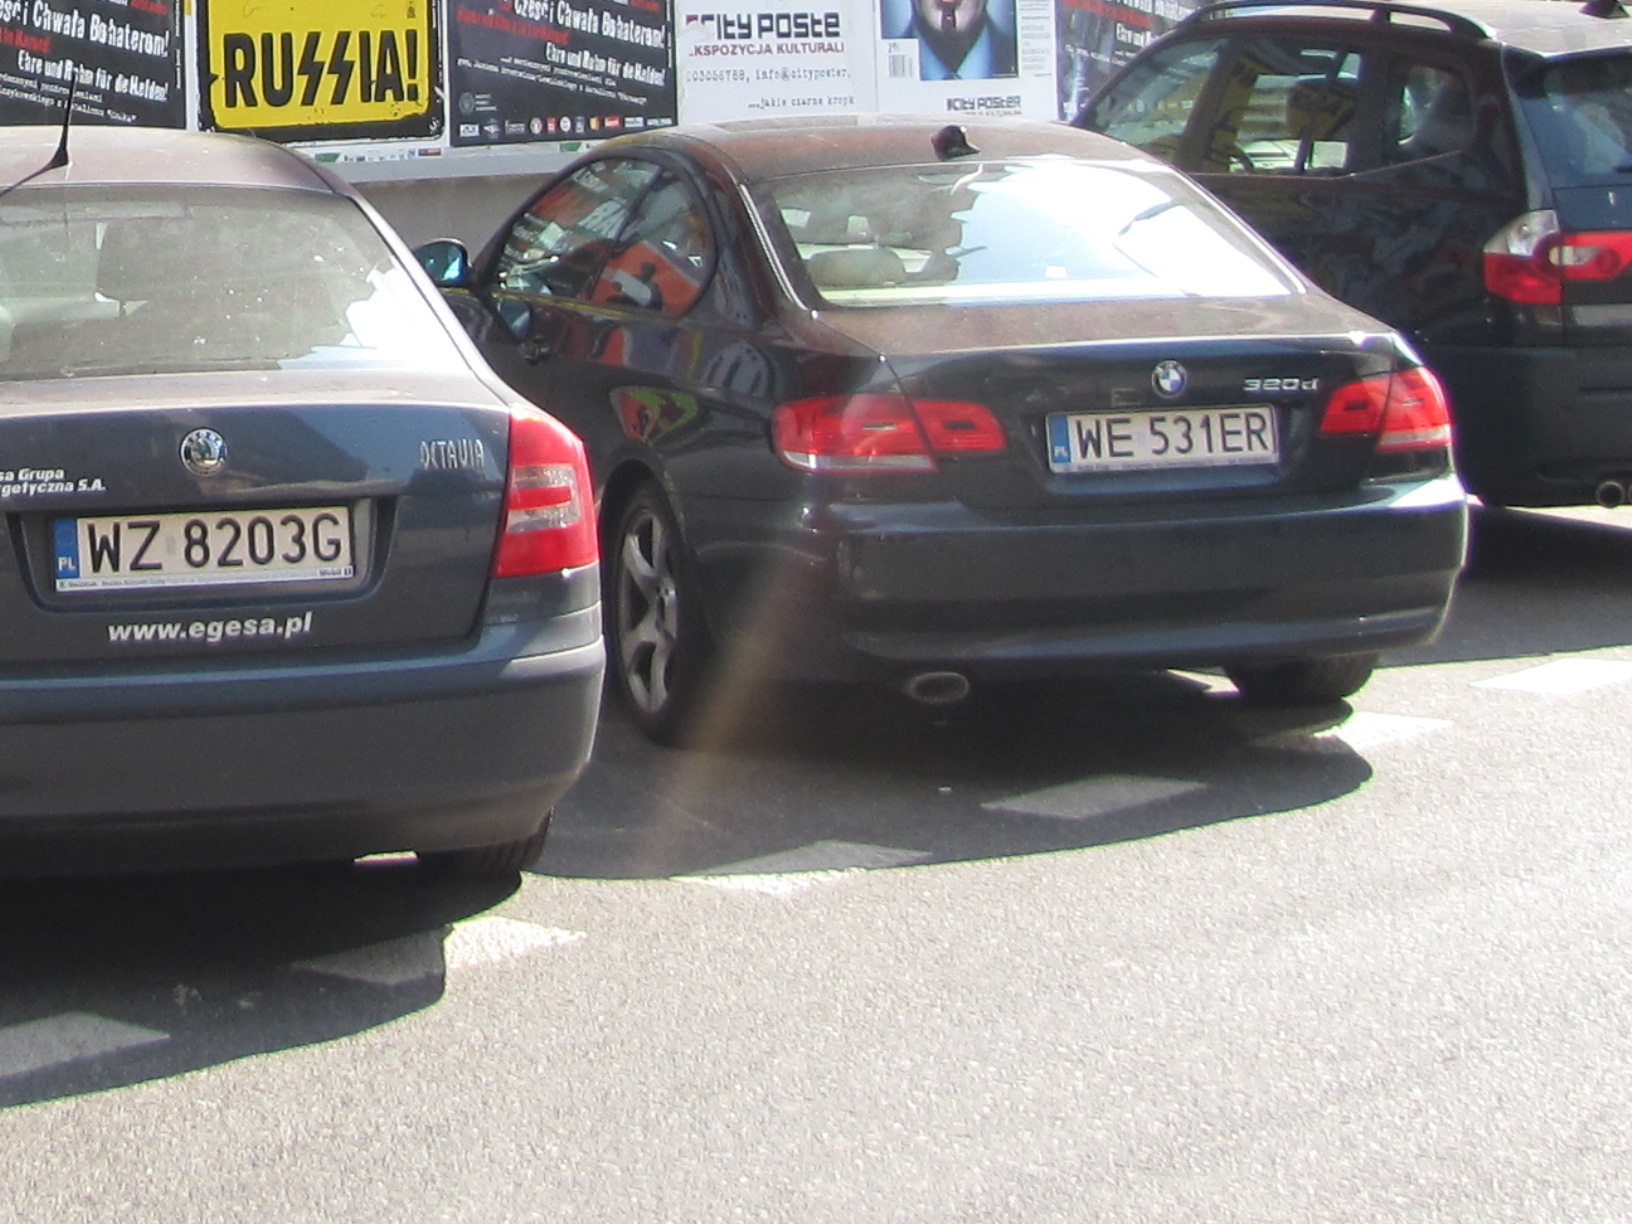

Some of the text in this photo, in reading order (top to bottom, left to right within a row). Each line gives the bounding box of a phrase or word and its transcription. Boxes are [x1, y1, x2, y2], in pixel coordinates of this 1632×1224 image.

[23, 1, 29, 26] i
[32, 0, 85, 39] Chwała
[89, 13, 169, 58] Bohaterom!
[689, 44, 773, 57] KSPOZYCJA
[18, 49, 43, 74] Ehre
[44, 59, 63, 80] und
[95, 67, 113, 90] für
[1243, 377, 1318, 391] 320d
[1076, 412, 1269, 459] WE 531ER
[19, 468, 64, 483] Grupa
[77, 479, 106, 492] S.A.
[87, 513, 342, 573] WZ 8203G
[58, 557, 76, 572] PL
[108, 611, 313, 642] www.egesa.pl
